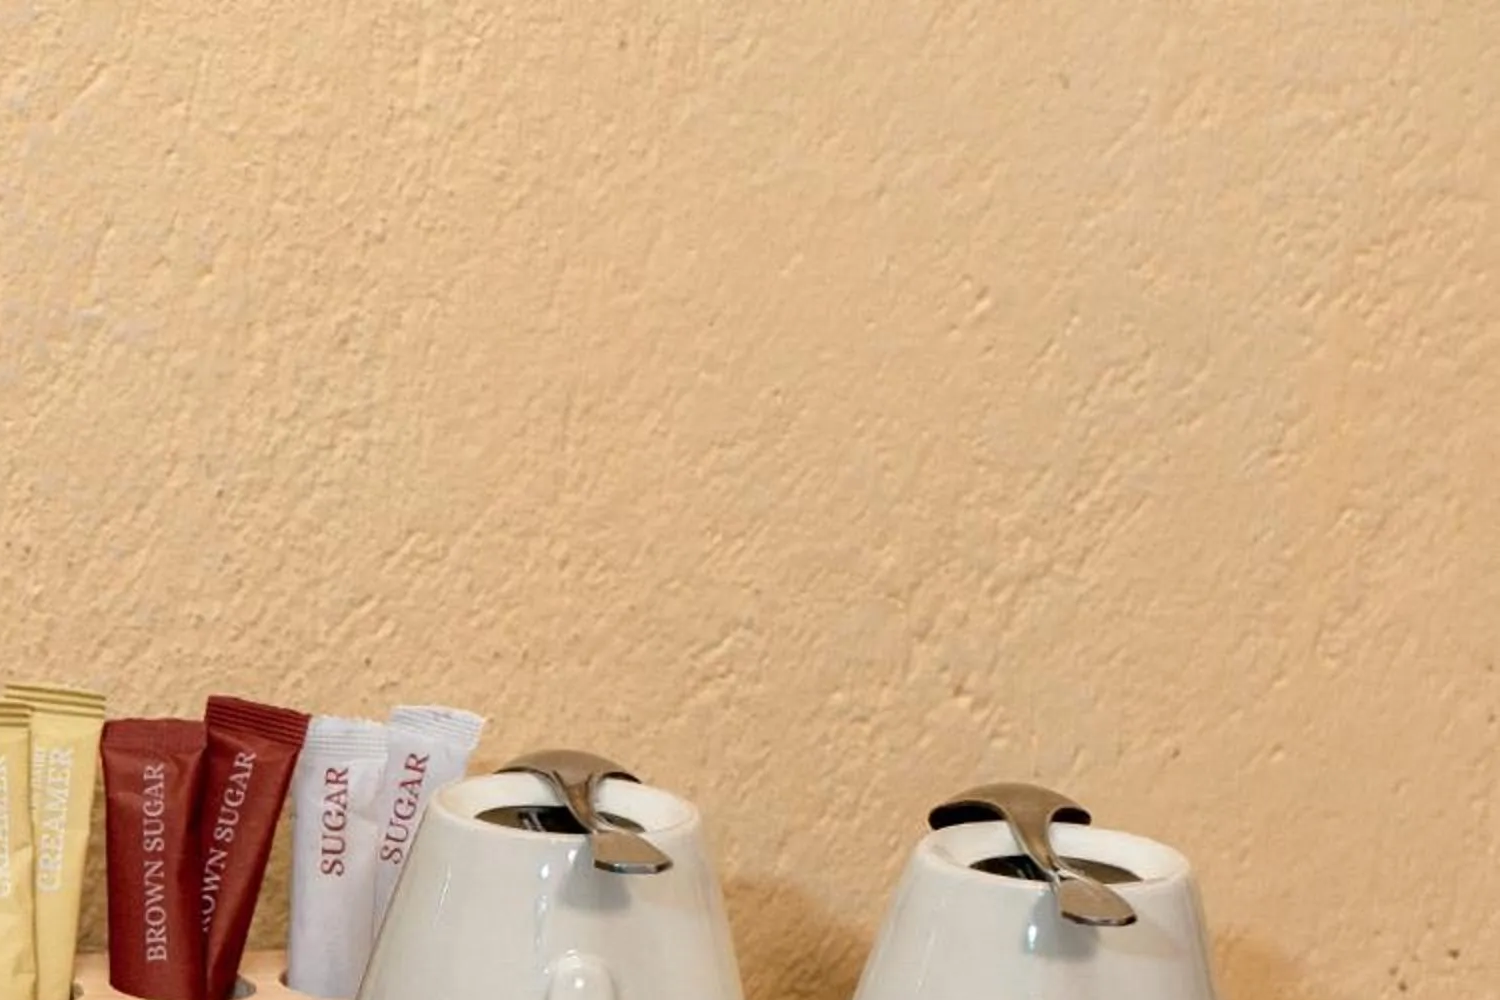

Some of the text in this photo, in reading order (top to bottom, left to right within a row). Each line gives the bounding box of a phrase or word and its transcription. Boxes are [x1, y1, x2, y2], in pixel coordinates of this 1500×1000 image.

[37, 748, 74, 891] CREAMER
[143, 762, 168, 962] BROWN SUGAR
[202, 751, 258, 932] OWN SUGAR
[320, 766, 350, 877] SUGAR
[380, 752, 431, 865] SUGAR
